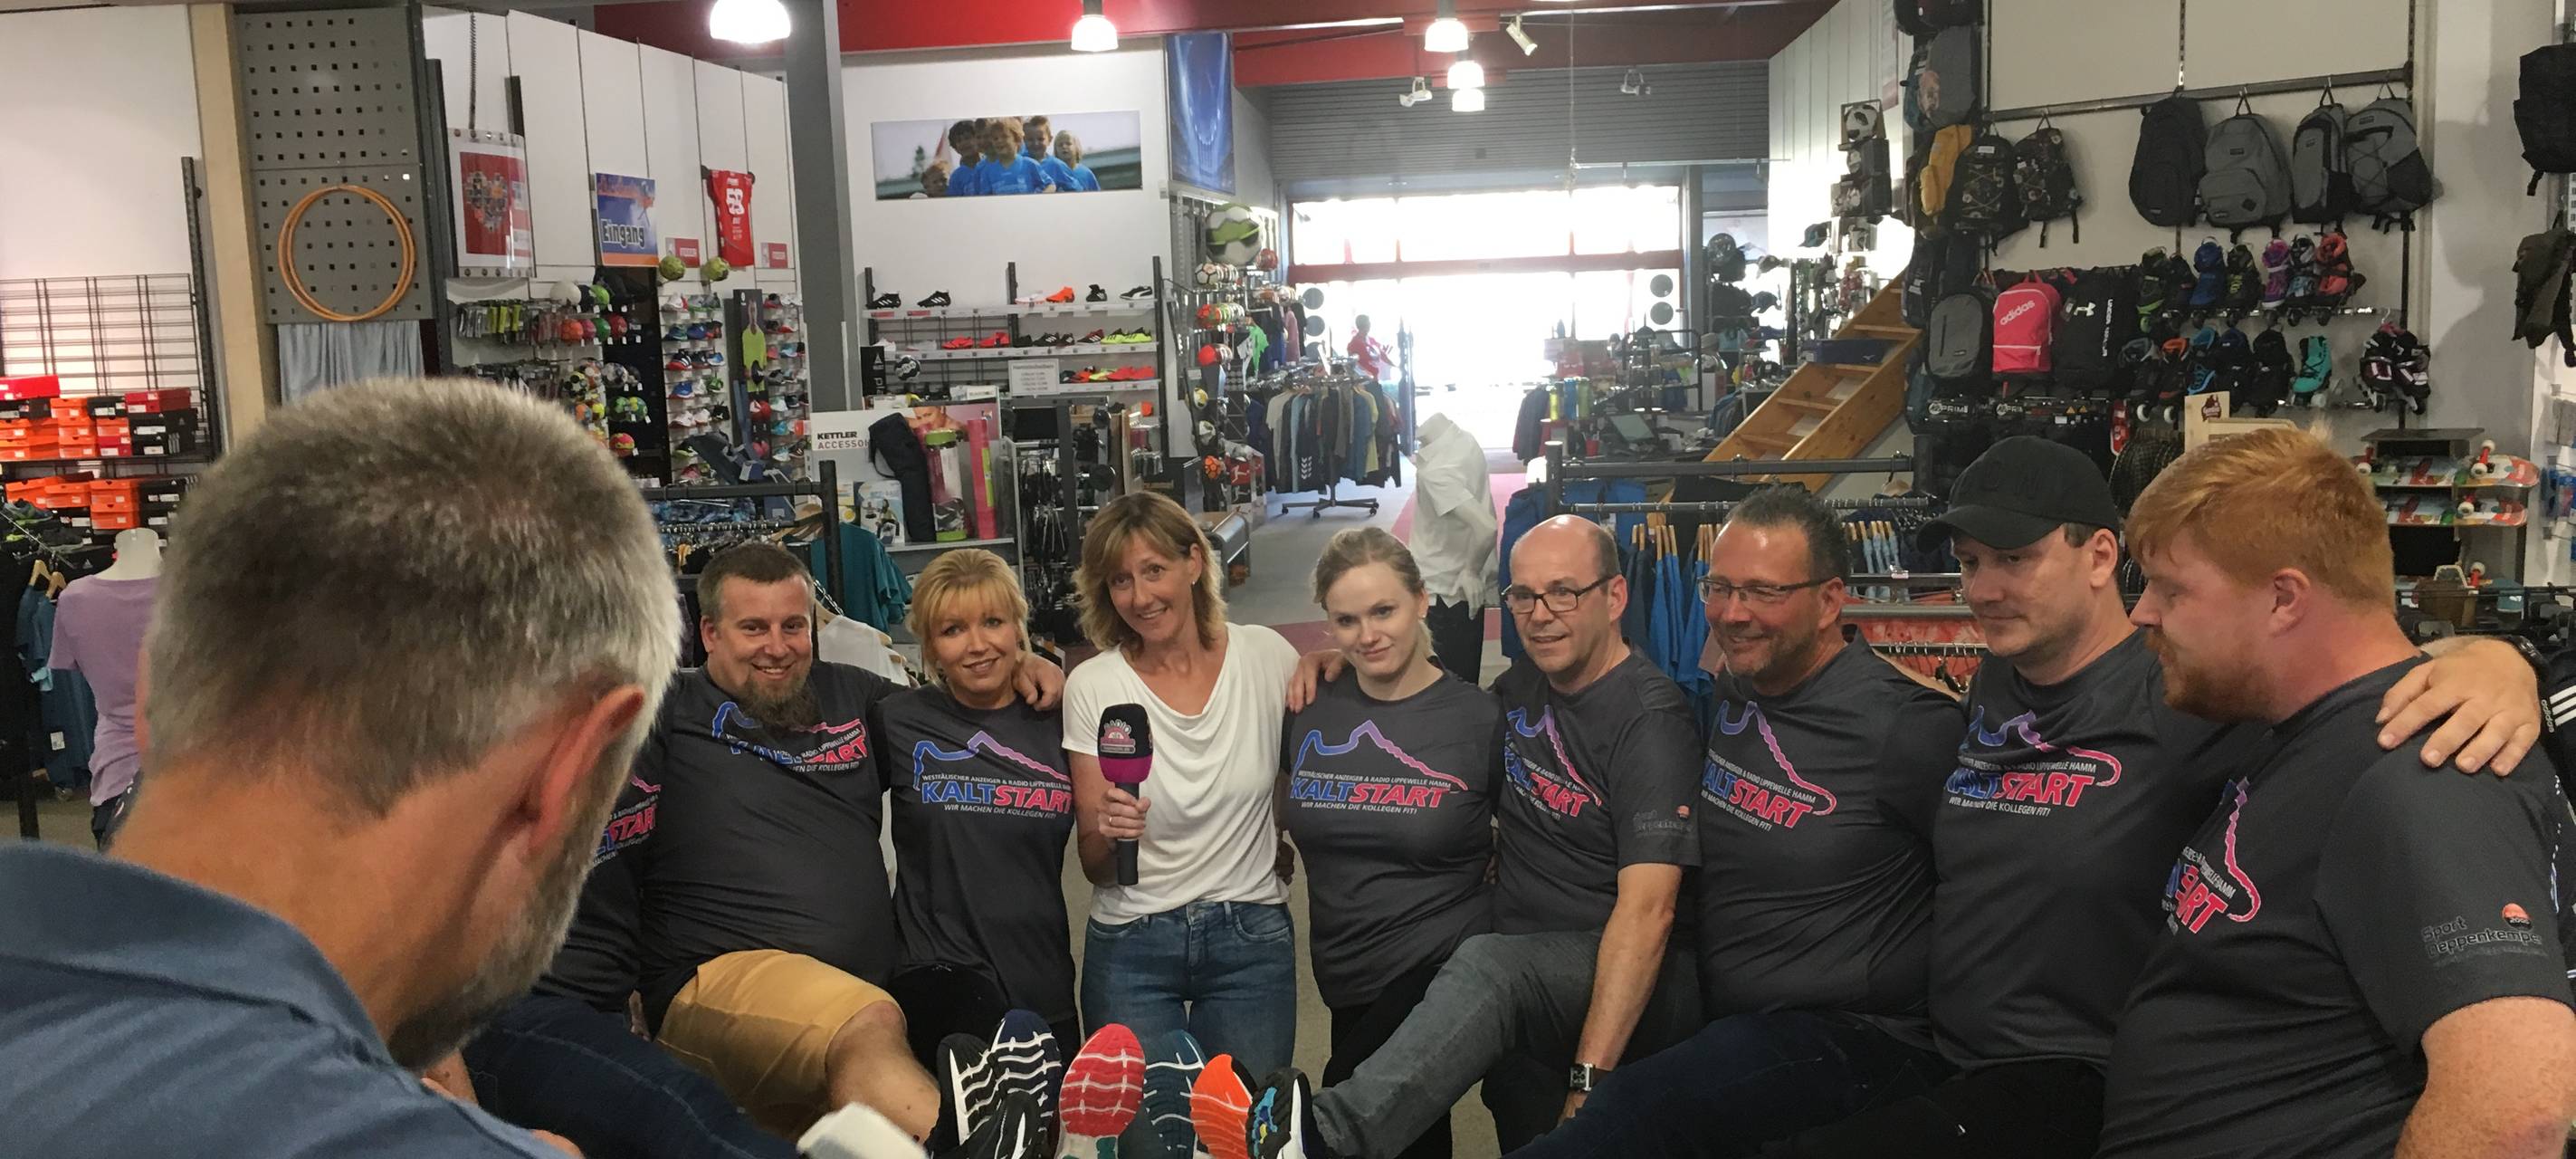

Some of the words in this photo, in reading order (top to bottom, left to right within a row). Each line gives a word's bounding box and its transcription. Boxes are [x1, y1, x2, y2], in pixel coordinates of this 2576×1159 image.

[601, 219, 645, 249] Eingang
[2000, 300, 2036, 326] adidas
[2105, 299, 2113, 325] UNDER
[816, 431, 858, 440] KETTLER
[817, 440, 870, 450] ACCESSO
[2542, 699, 2554, 733] adidas
[921, 772, 969, 781] WESTFÄLISCHER
[971, 776, 1000, 784] ANZEIGER
[2068, 761, 2096, 773] HAMM
[1290, 777, 1450, 809] KALTSTART
[1334, 773, 1363, 782] ANZEIGER
[1391, 777, 1427, 785] LIPPEWELLE
[1428, 780, 1451, 788] HAMM
[1760, 778, 1792, 796] LIPPEWELLE
[1793, 790, 1817, 803] HAMM
[921, 781, 1072, 814] KALTSTART
[1314, 802, 1347, 810] MACHEN
[1362, 805, 1401, 814] KOLLEGEN
[1402, 807, 1417, 815] FIT!
[1949, 797, 1961, 805] WIR
[1985, 800, 1998, 811] DIE
[1999, 802, 2036, 815] KOLLEGEN
[2036, 807, 2051, 817] FIT!
[960, 805, 992, 813] MACHEN
[1007, 809, 1044, 819] KOLLEGEN
[1726, 803, 1734, 814] DIE
[1734, 806, 1760, 827] KOLLEGEN
[1759, 819, 1772, 832] FIT!
[2421, 915, 2468, 943] Sport
